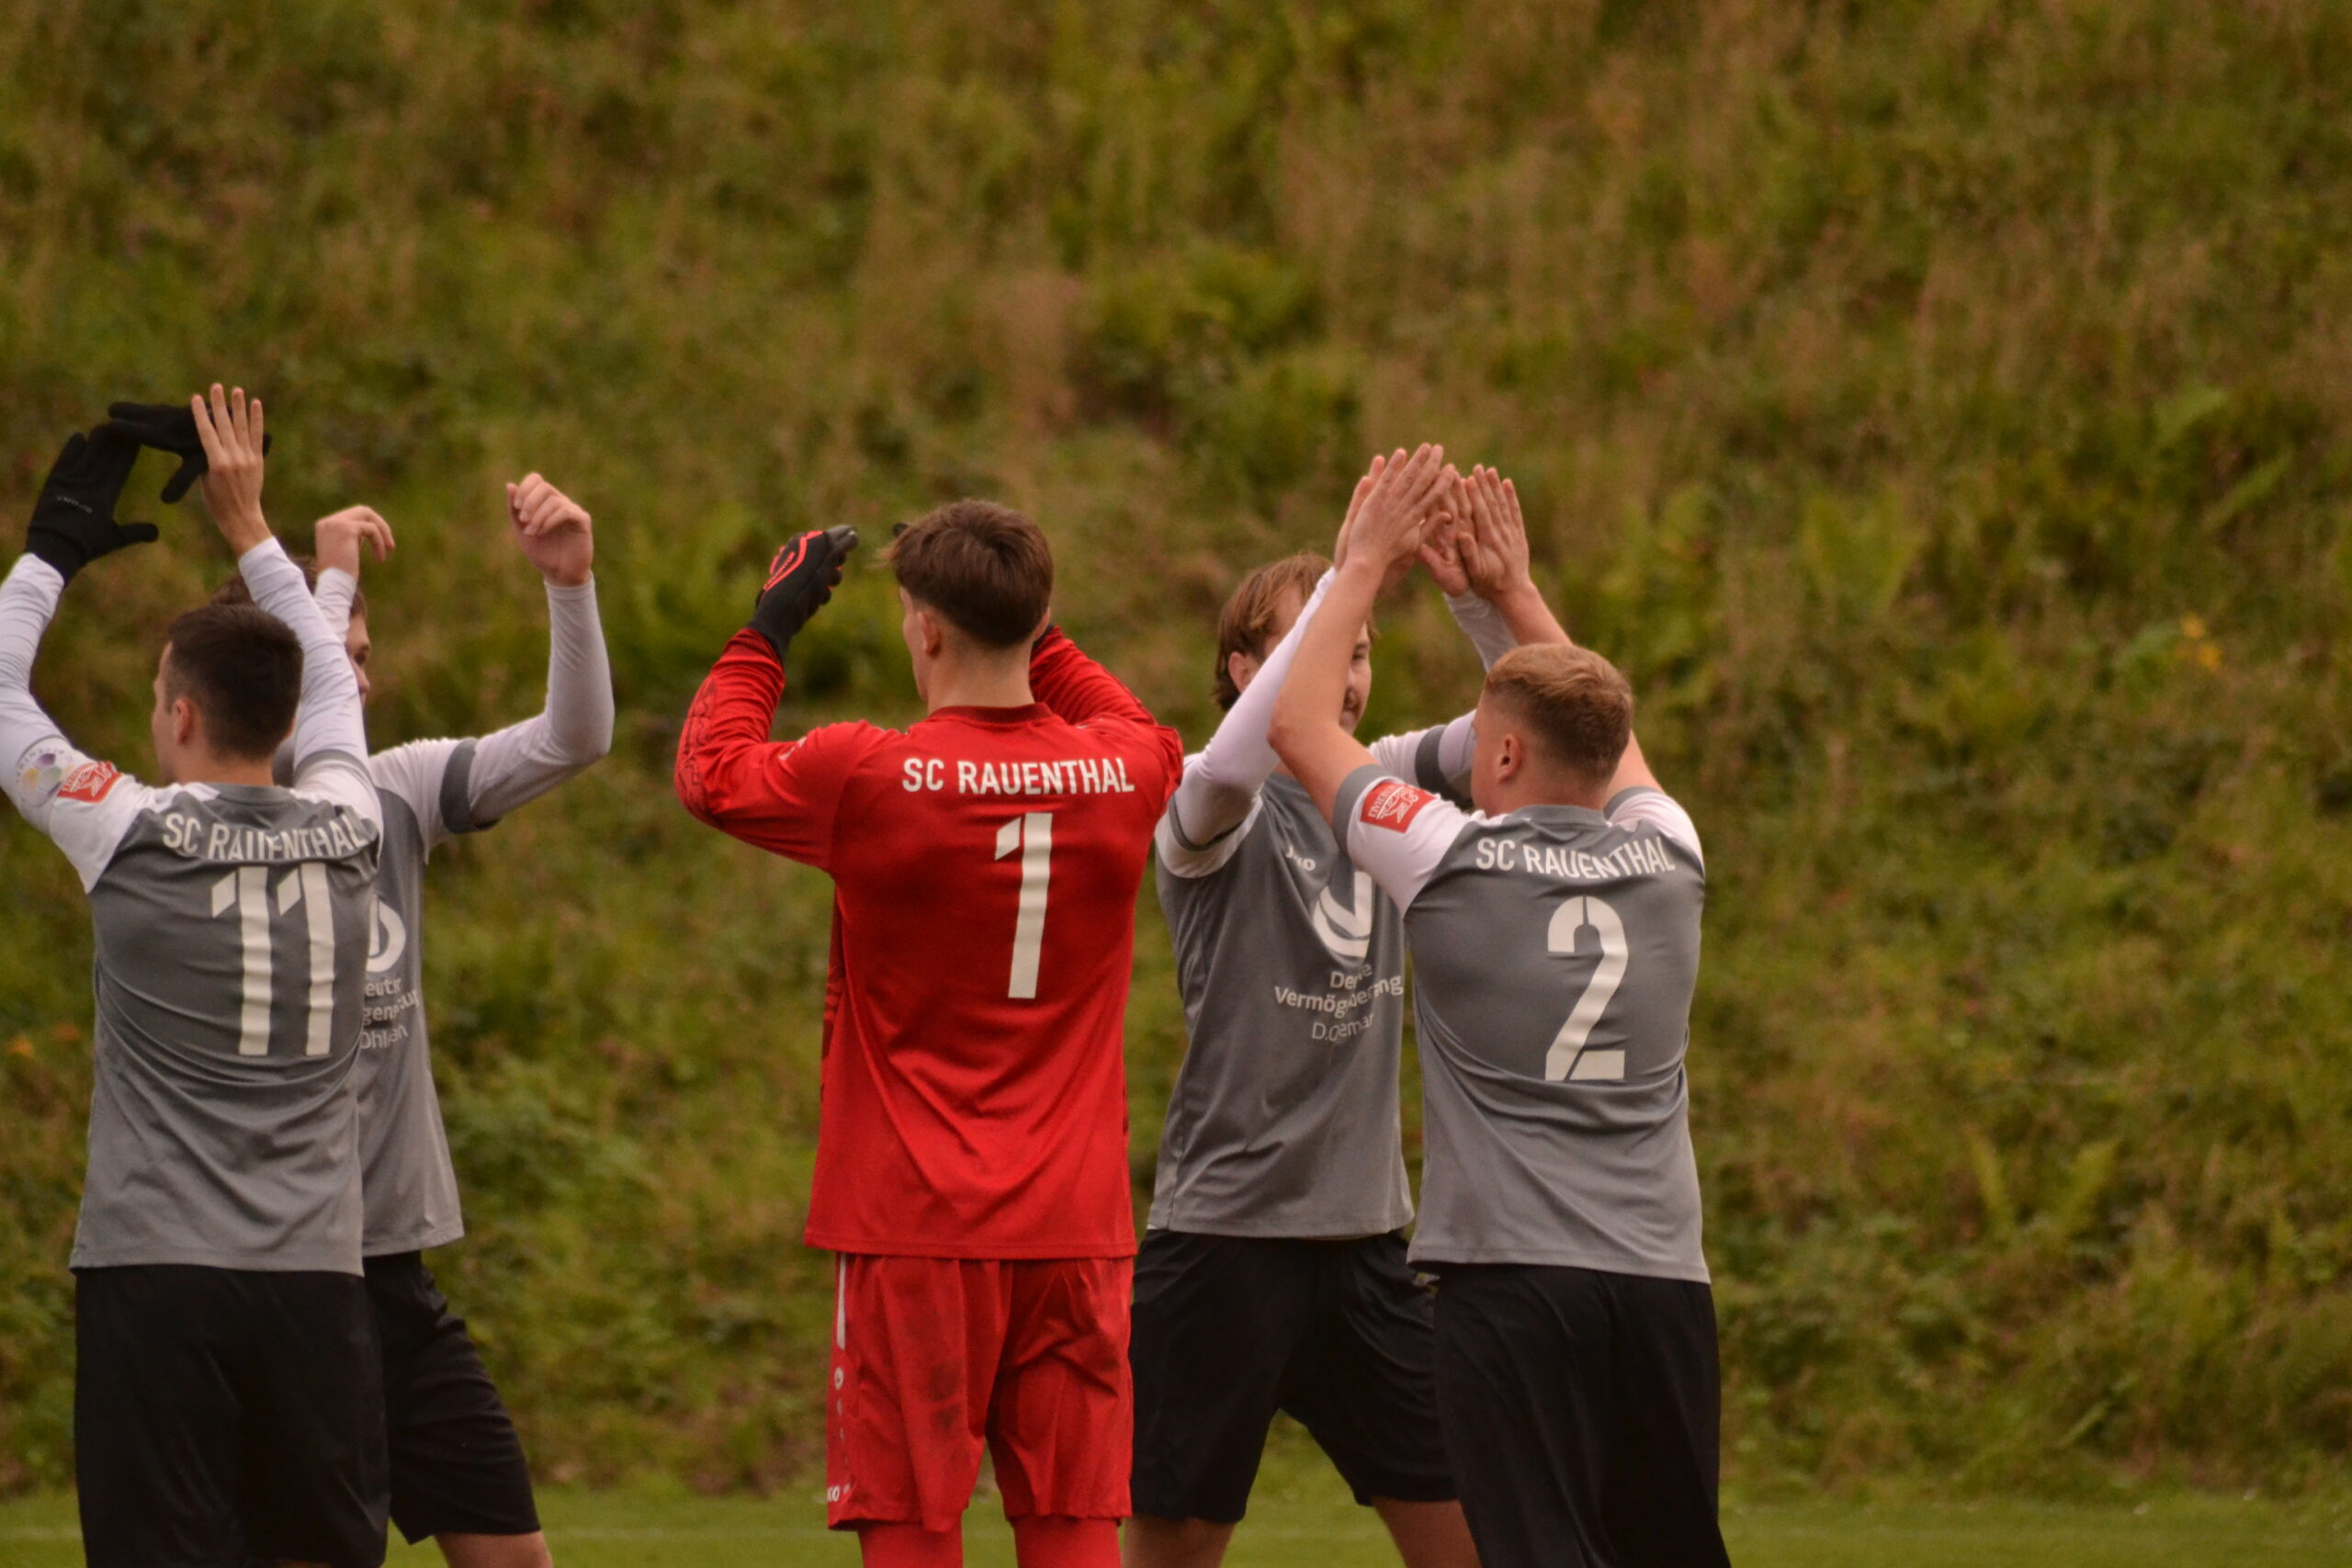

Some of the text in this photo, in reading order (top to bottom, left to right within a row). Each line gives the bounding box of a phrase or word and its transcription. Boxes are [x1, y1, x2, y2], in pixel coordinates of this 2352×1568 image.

[164, 812, 201, 854] SC
[902, 757, 1136, 795] SC RAUENTHAL
[995, 812, 1054, 999] 1
[1476, 836, 1677, 880] SC RAUENTHAL
[211, 862, 335, 1055] 11
[1545, 896, 1629, 1081] 2
